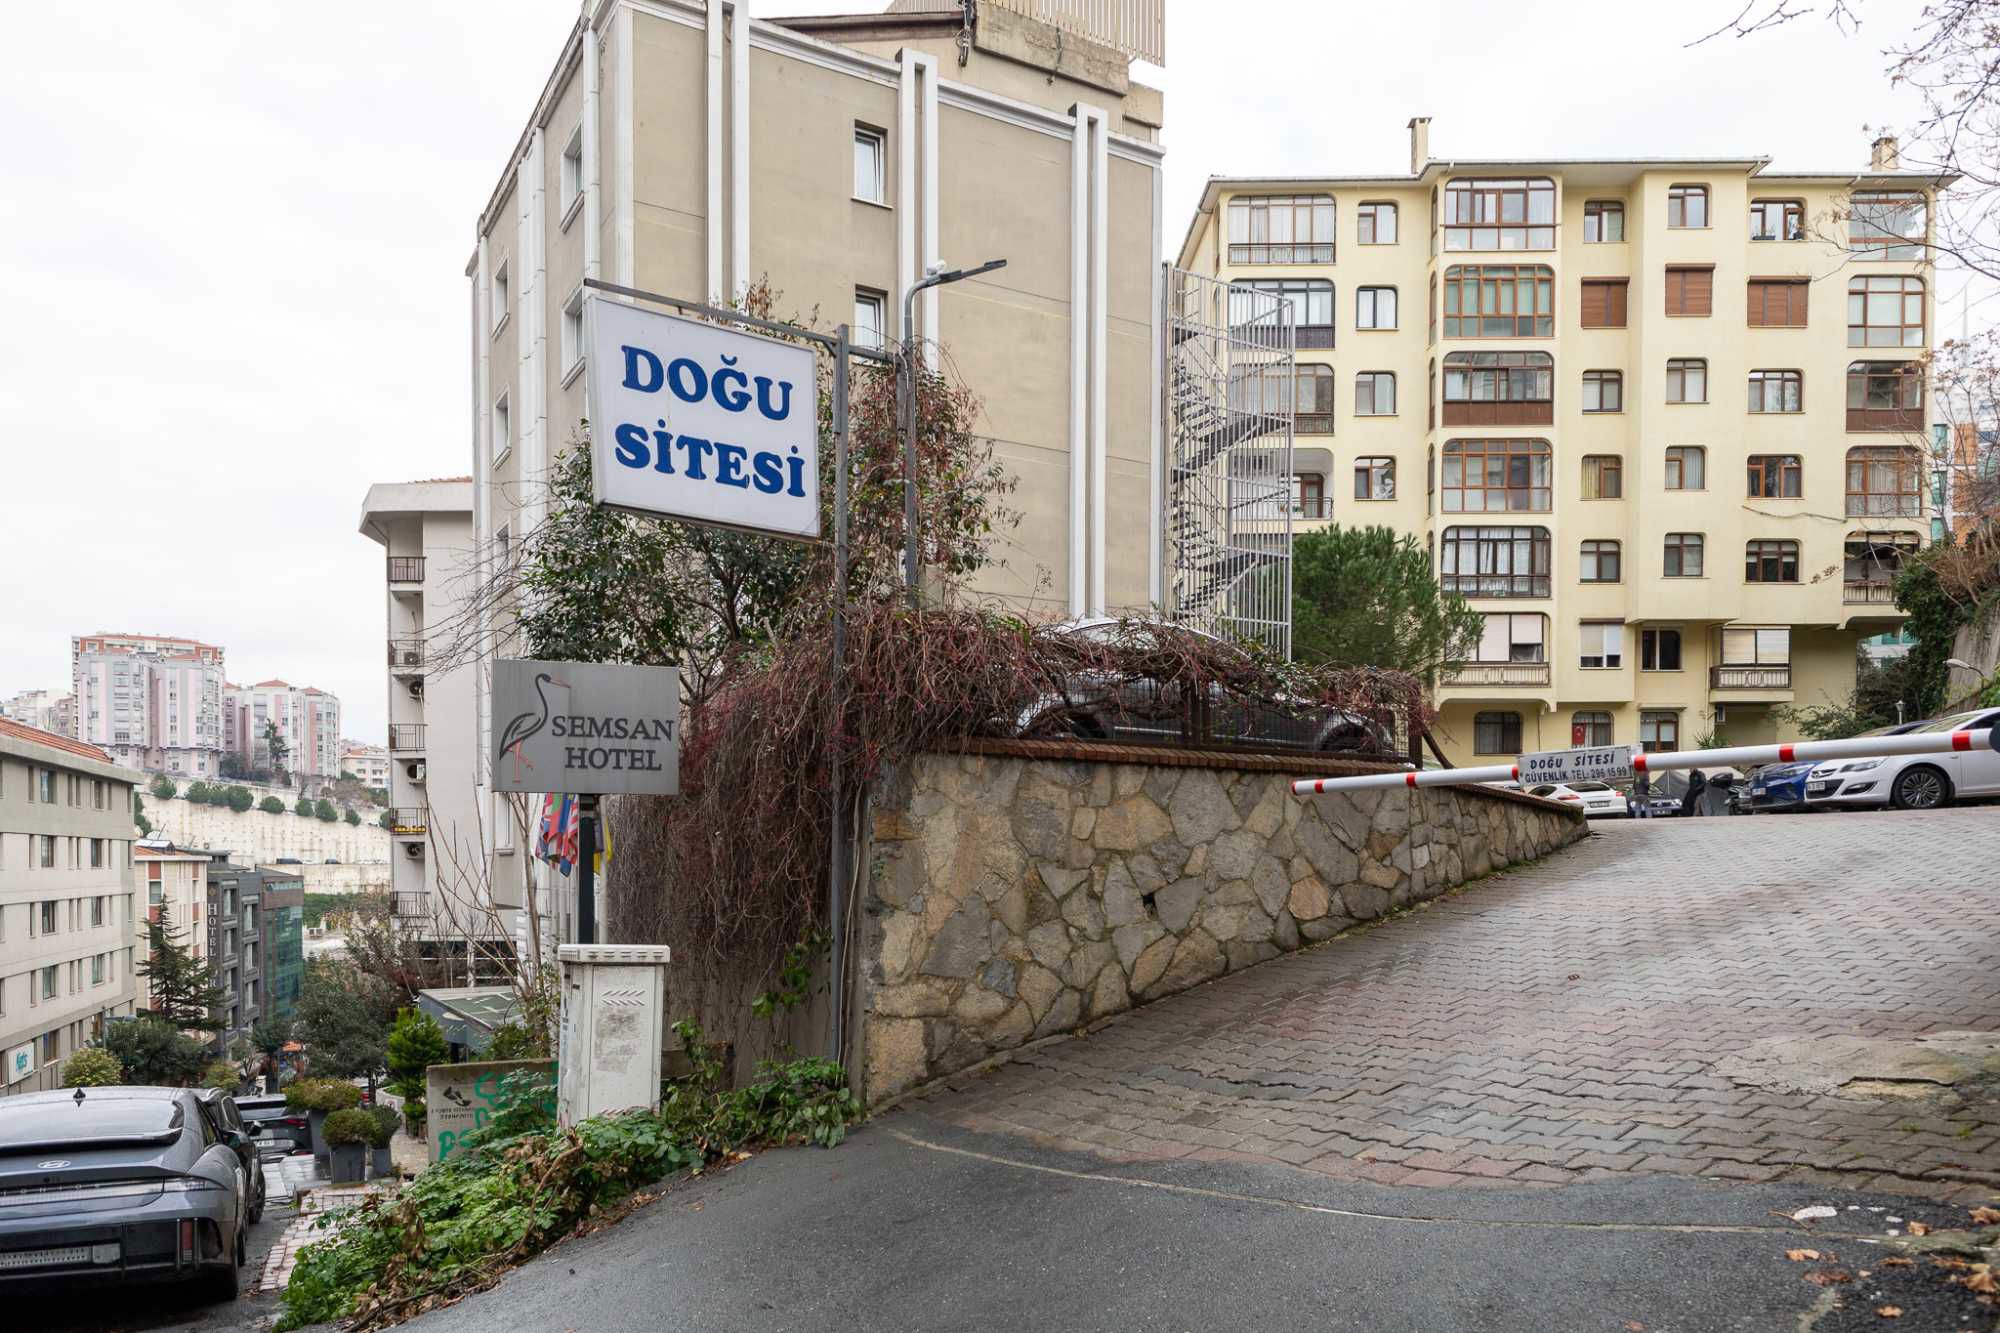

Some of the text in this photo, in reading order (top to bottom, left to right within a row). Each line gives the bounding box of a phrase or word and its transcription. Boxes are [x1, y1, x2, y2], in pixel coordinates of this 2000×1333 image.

[621, 344, 793, 421] DOĞU
[615, 419, 806, 498] SİTESİ
[551, 715, 674, 741] SEMSAN
[565, 747, 662, 771] HOTEL
[1530, 751, 1614, 769] DOĞU SİTESİ
[207, 903, 218, 957] HOTEL
